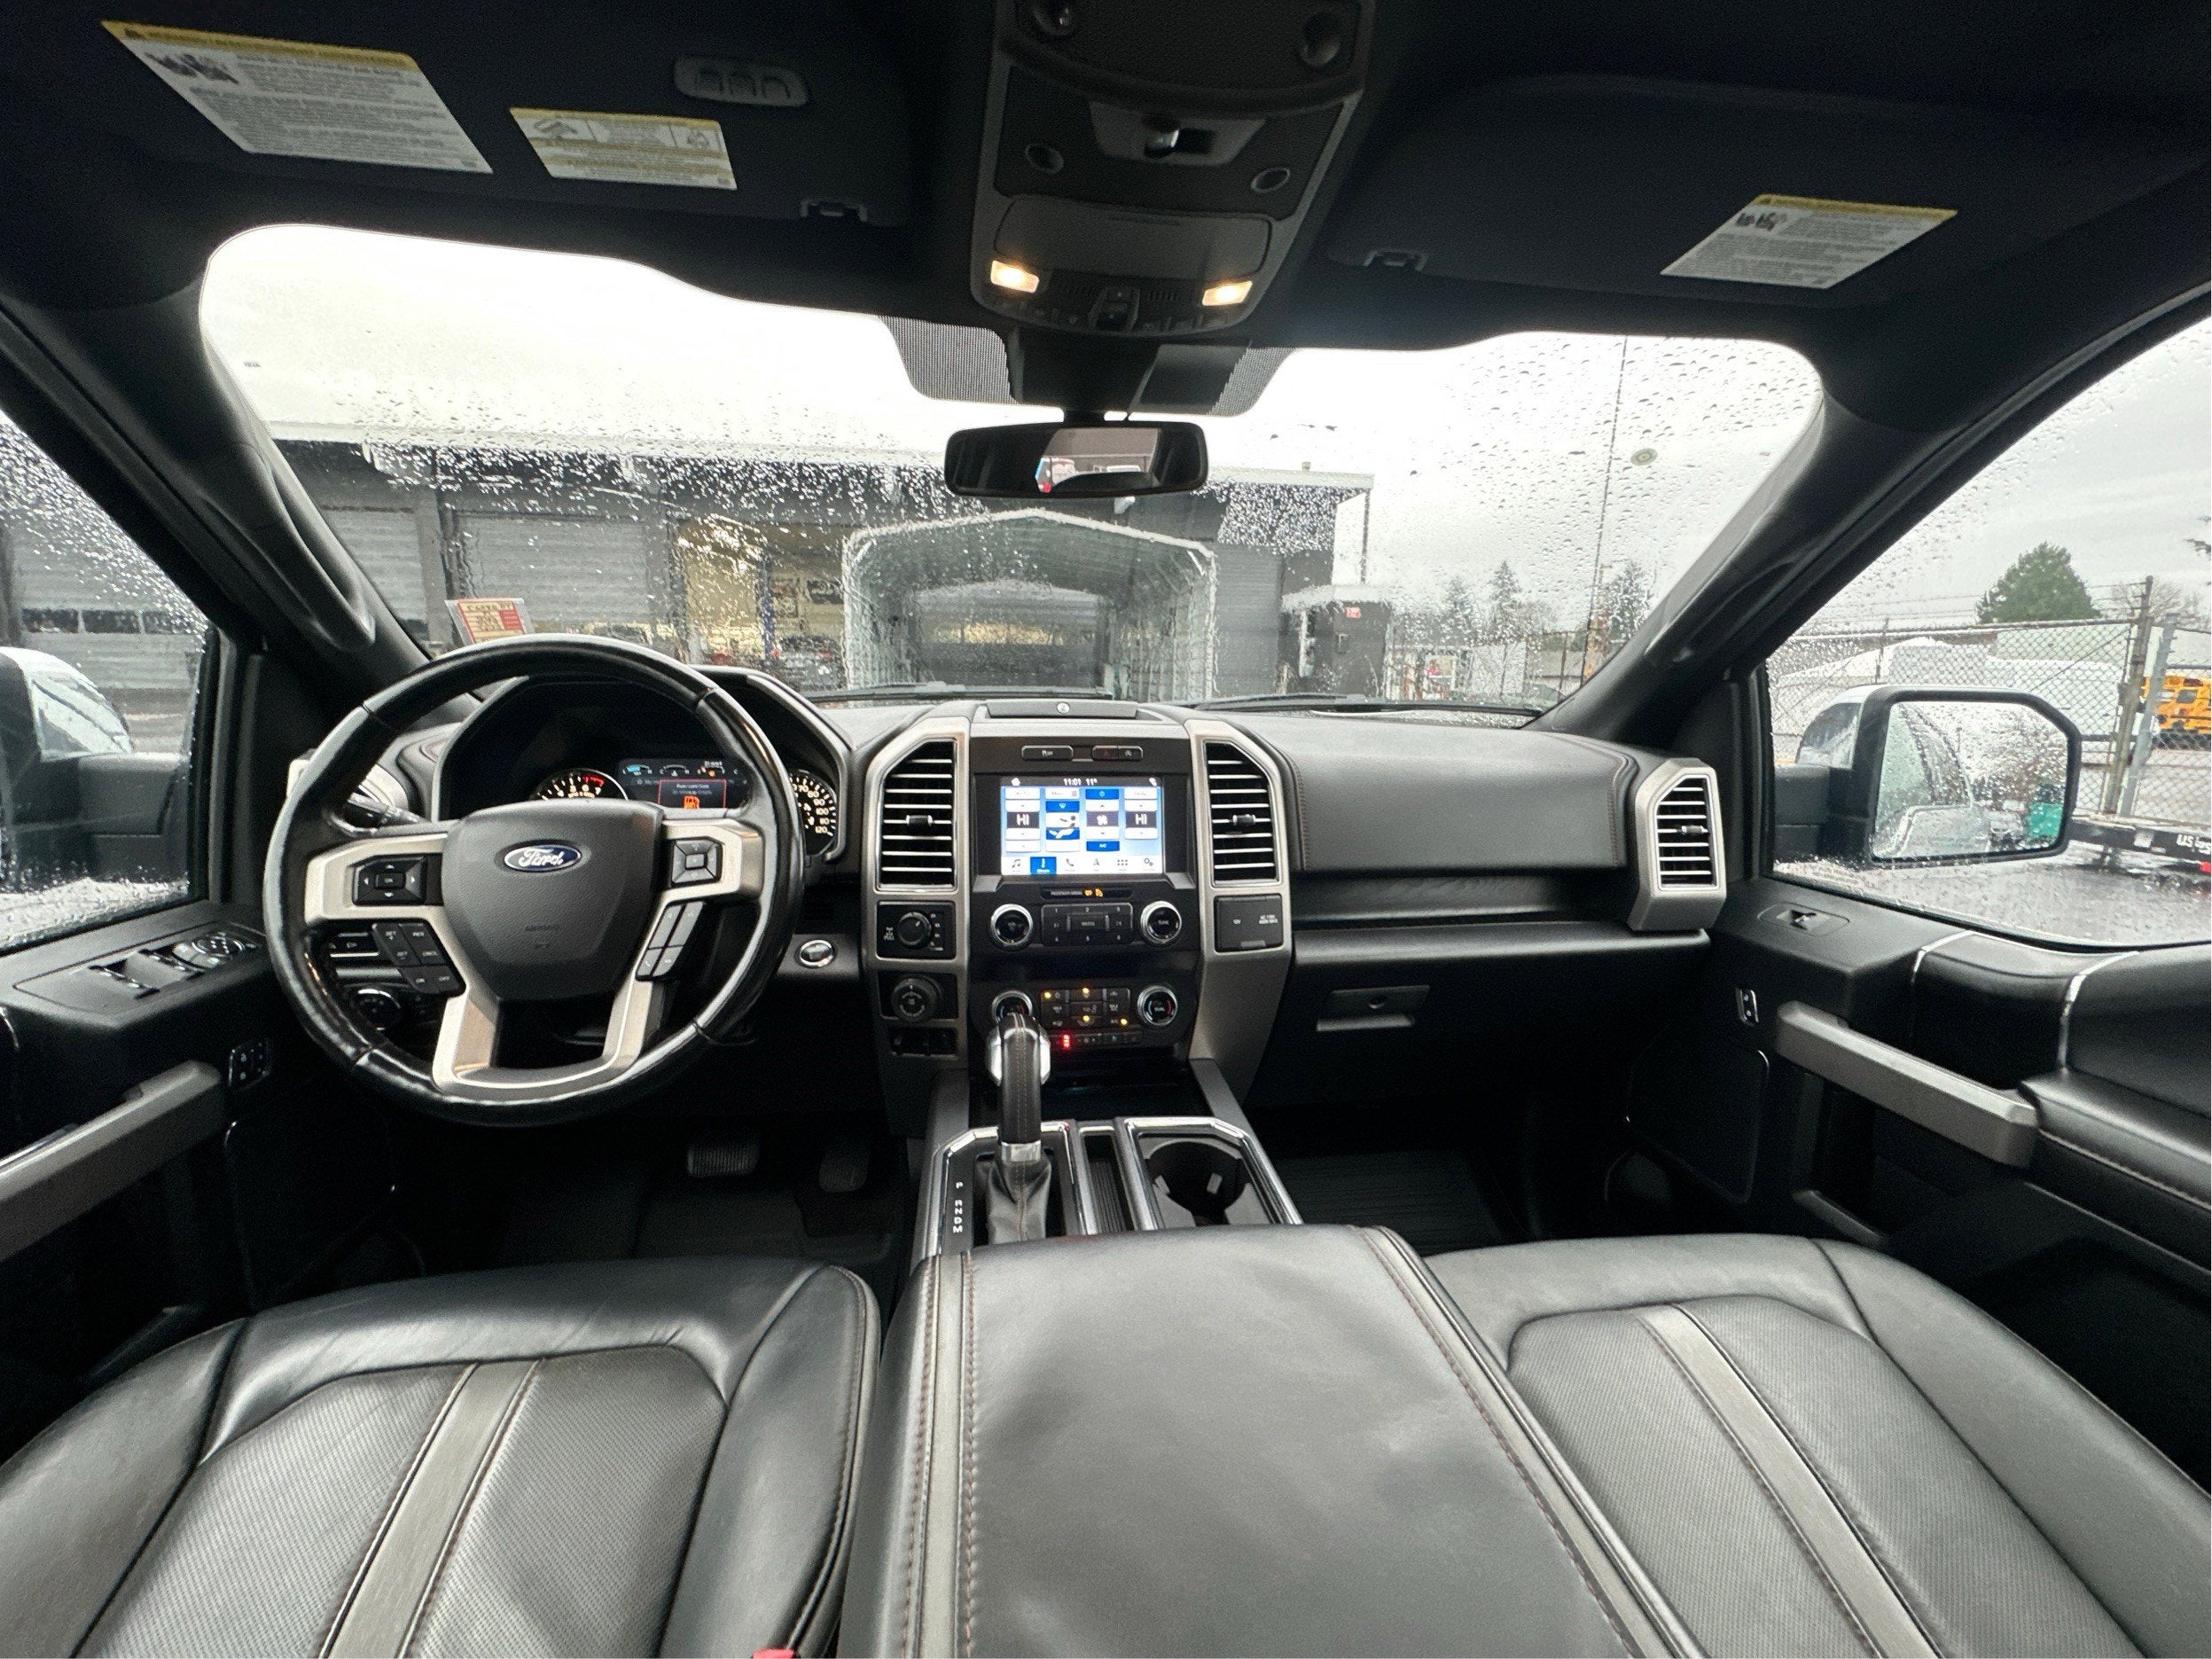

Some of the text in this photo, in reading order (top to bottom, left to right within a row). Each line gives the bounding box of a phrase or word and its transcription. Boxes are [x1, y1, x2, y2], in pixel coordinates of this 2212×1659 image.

[816, 807, 830, 816] 100
[1016, 813, 1030, 826] HI
[1135, 813, 1148, 826] HI
[518, 851, 565, 868] Ford
[954, 1216, 963, 1225] D
[952, 1225, 963, 1233] M
